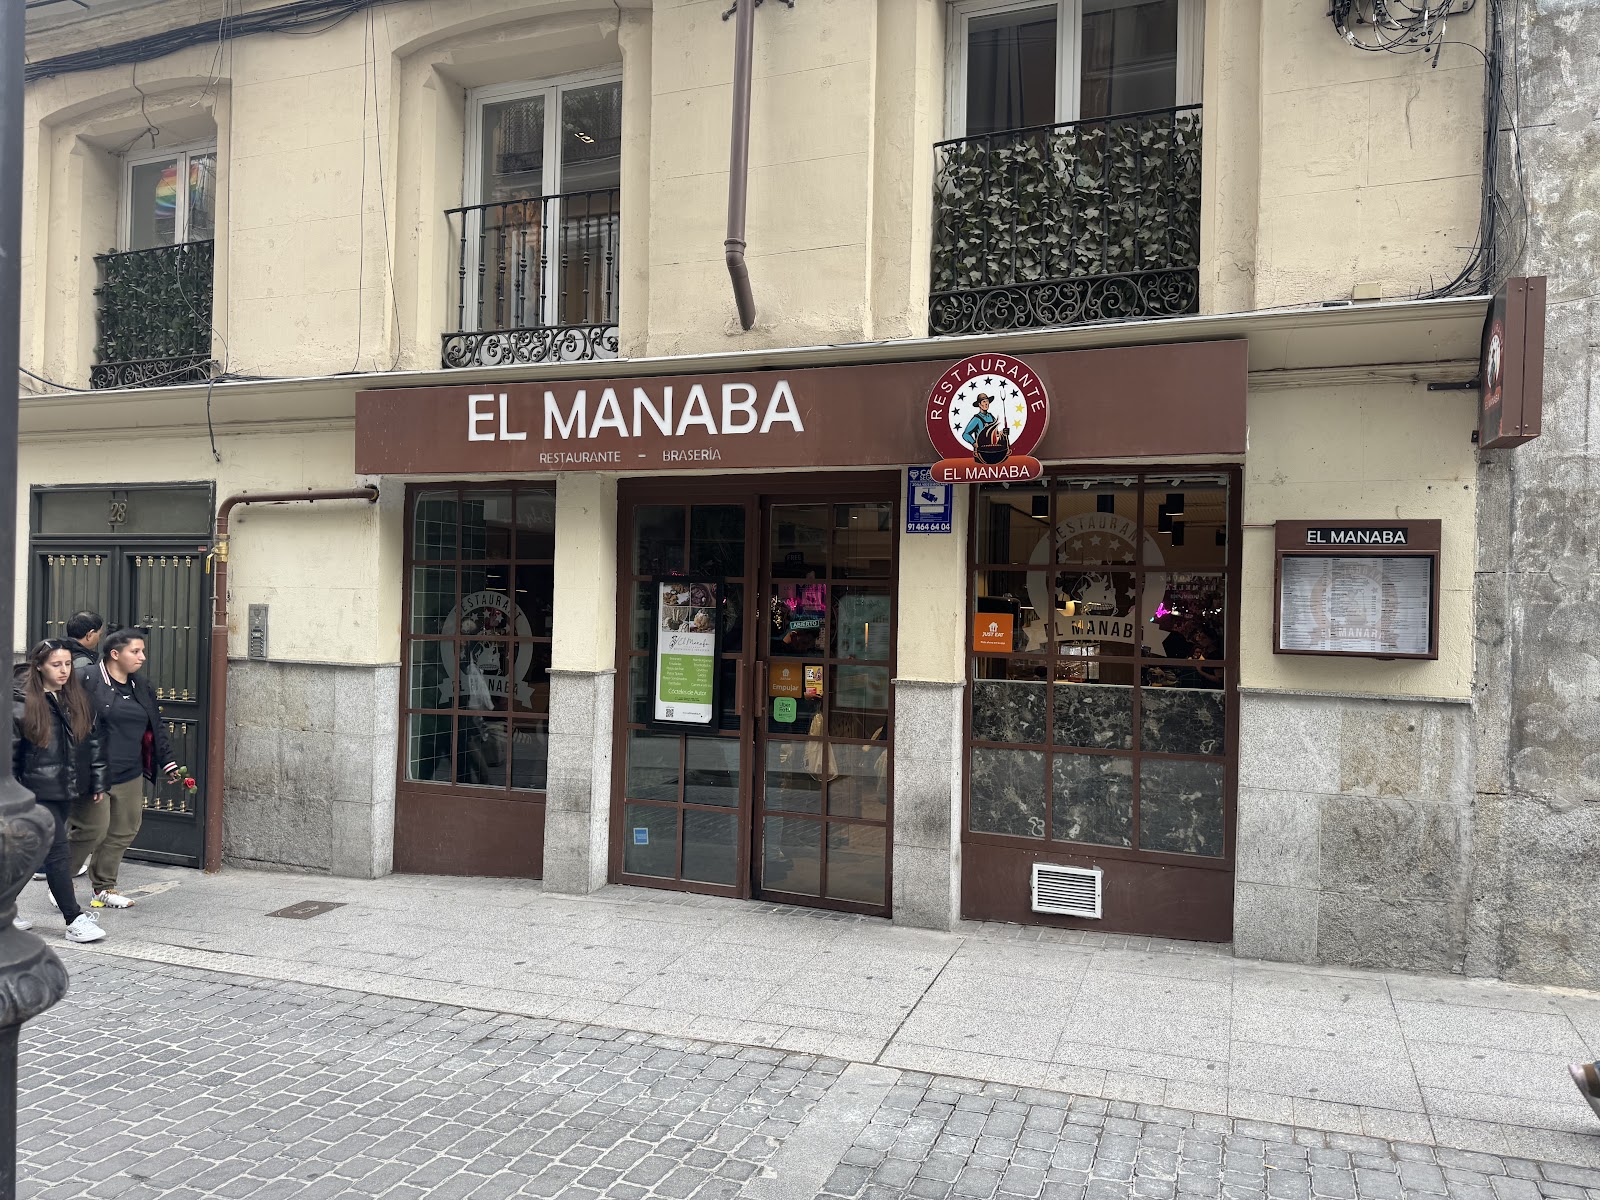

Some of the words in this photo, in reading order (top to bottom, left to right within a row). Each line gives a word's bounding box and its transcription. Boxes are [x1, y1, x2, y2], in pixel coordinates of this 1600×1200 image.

[930, 358, 1045, 420] RESTAURANTE
[467, 393, 527, 442] EL
[544, 379, 805, 440] MANABA
[539, 450, 621, 464] RESTAURANTE
[662, 448, 722, 463] BRASERÍA
[943, 467, 962, 481] EL
[965, 465, 1031, 480] MANABA
[110, 502, 127, 522] 28
[907, 523, 915, 531] 91
[915, 523, 930, 531] 464
[930, 523, 940, 531] 64
[940, 523, 950, 531] 04
[1307, 530, 1326, 543] EL
[1330, 530, 1406, 544] MANABA
[772, 683, 799, 692] Empujar
